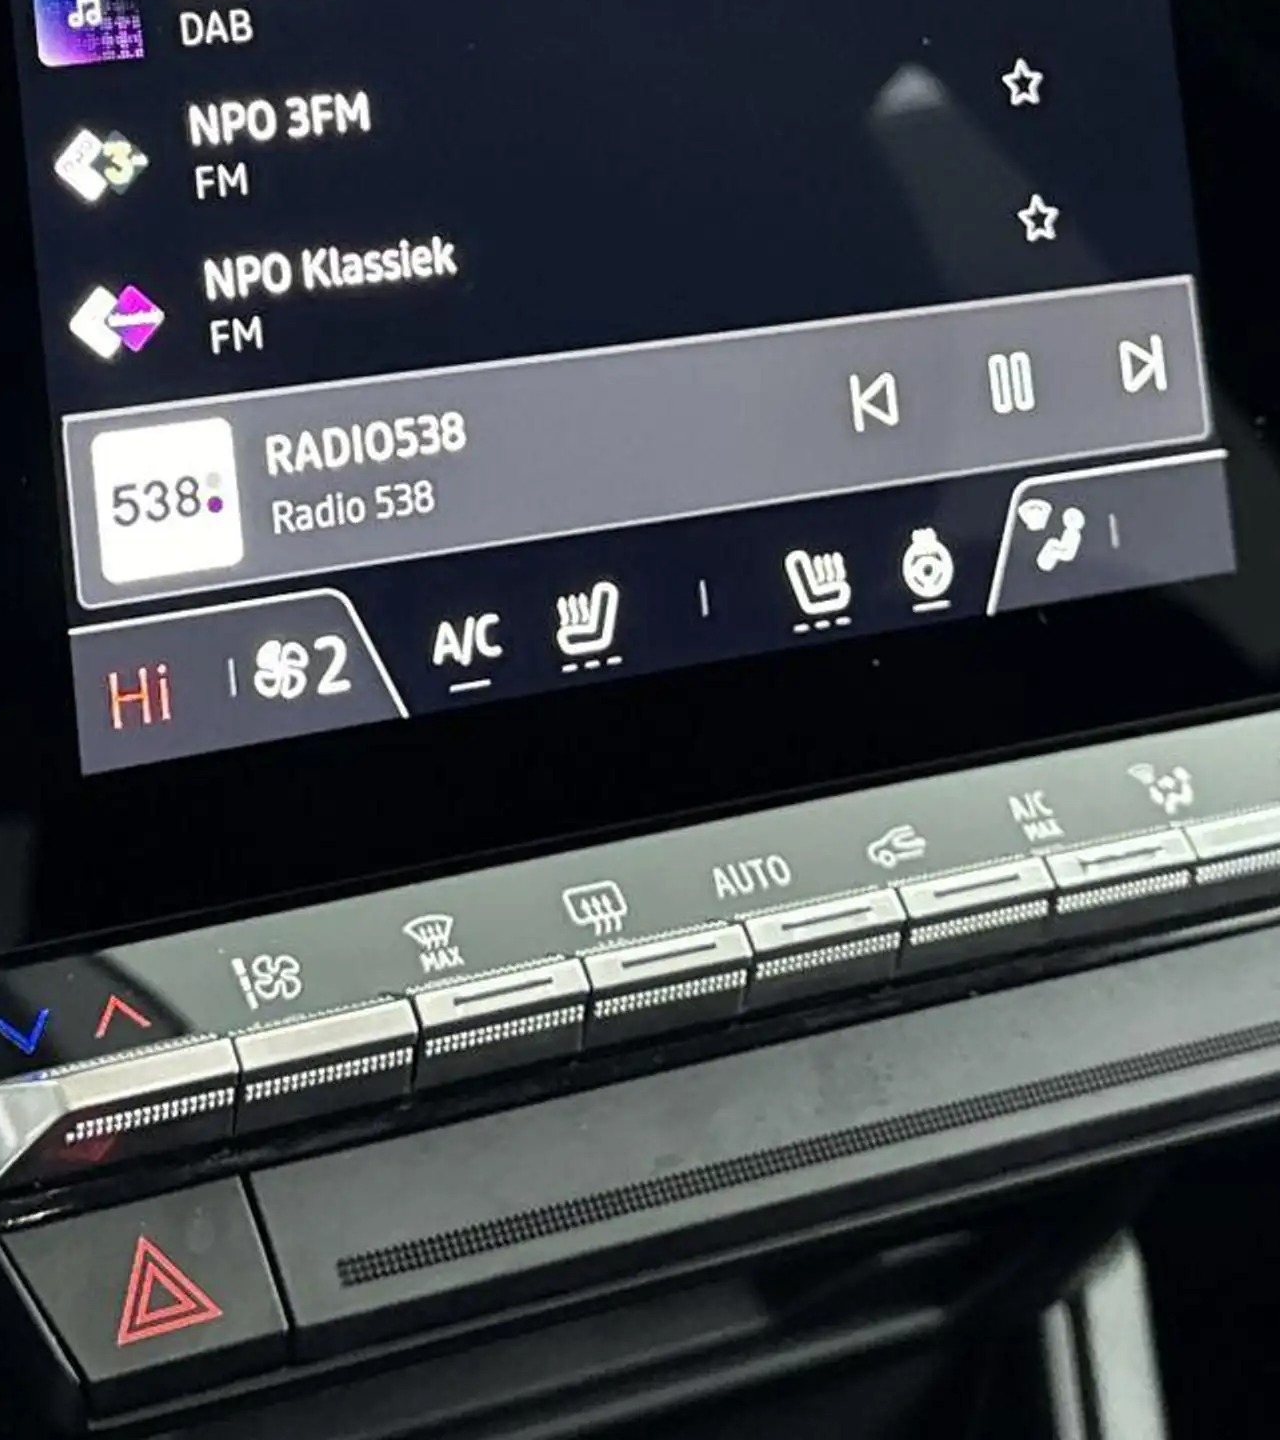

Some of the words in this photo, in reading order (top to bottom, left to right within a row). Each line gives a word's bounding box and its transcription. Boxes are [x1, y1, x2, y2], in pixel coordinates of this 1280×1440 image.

[179, 8, 253, 46] DAB
[188, 98, 277, 147] NPO
[284, 90, 371, 139] 3FM
[195, 162, 248, 200] FM
[203, 253, 293, 301] NPO
[301, 235, 458, 291] Klassiek
[210, 315, 264, 355] FM
[265, 411, 467, 477] RADIO538
[111, 476, 202, 527] 538
[272, 491, 366, 535] Radio
[374, 479, 435, 520] 538
[313, 635, 352, 695] 2
[432, 613, 503, 667] A/C
[109, 663, 171, 730] Hi
[1008, 789, 1054, 822] A/C
[712, 854, 792, 900] AUTO
[420, 945, 465, 973] MAX
